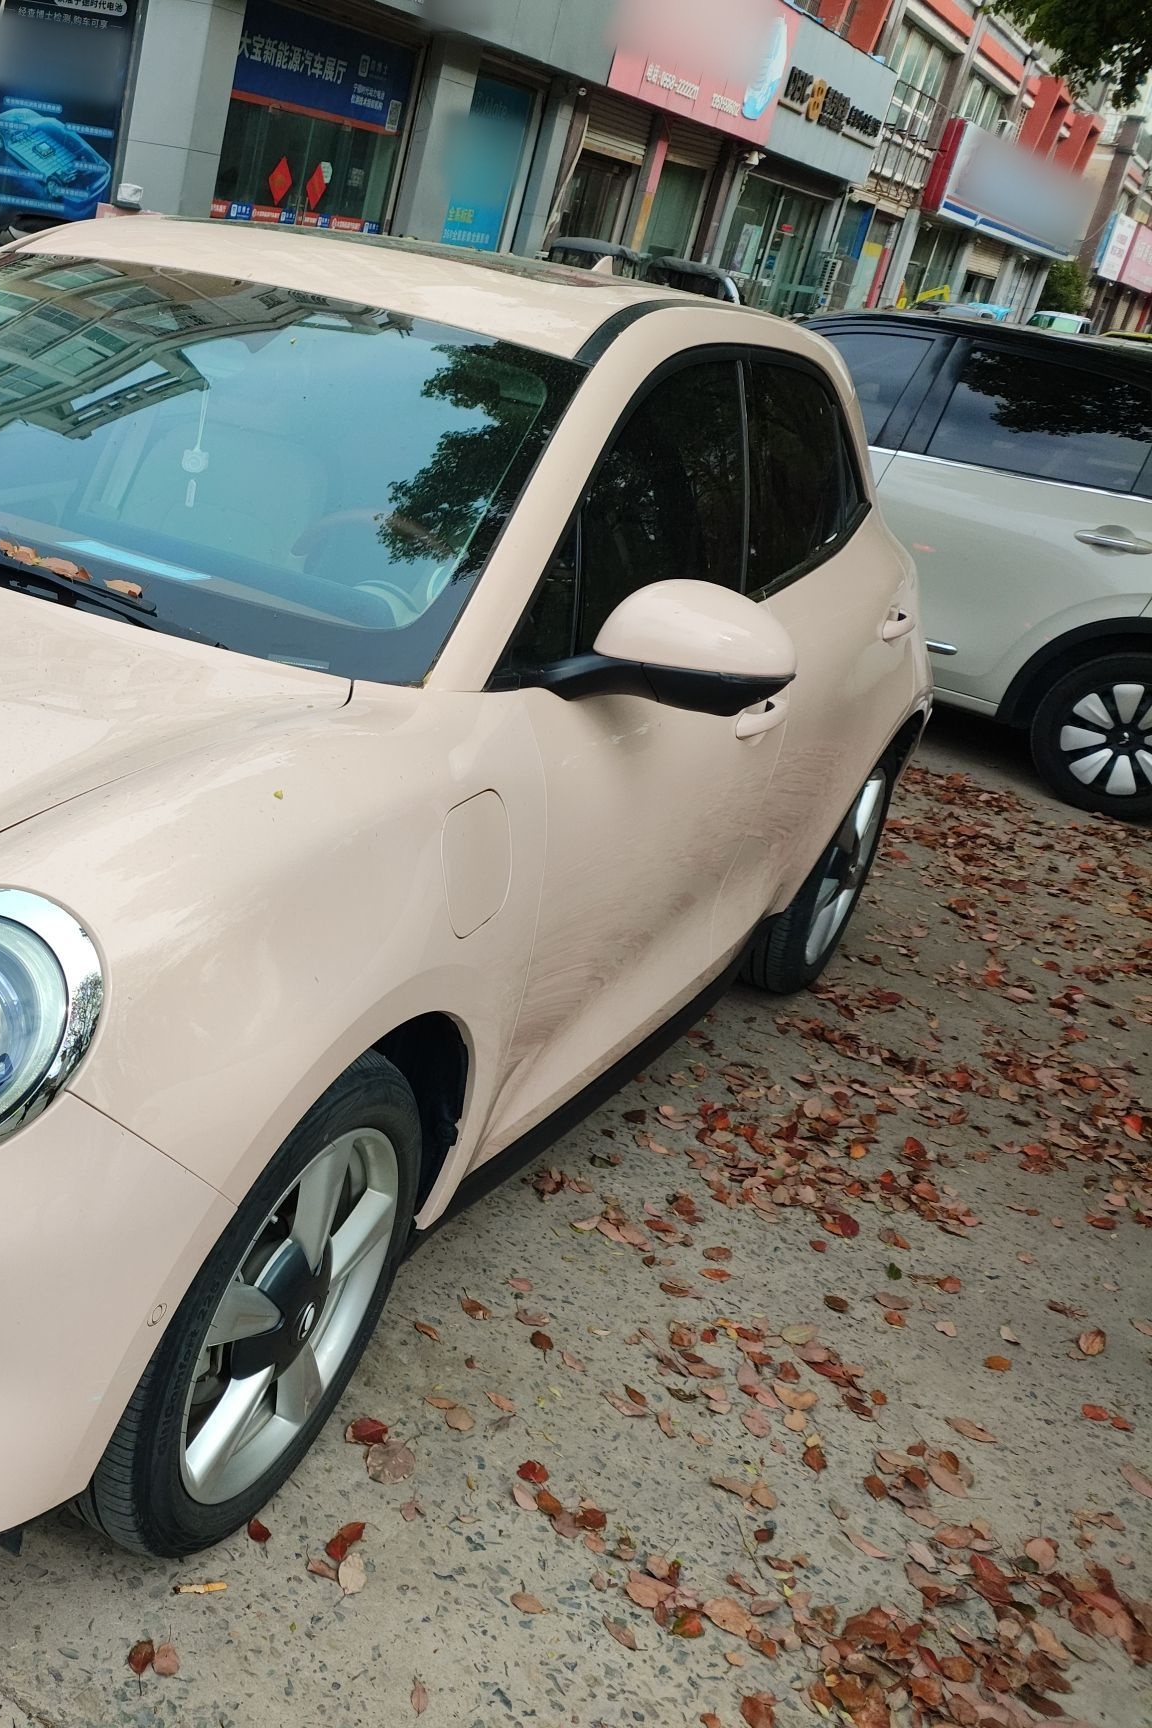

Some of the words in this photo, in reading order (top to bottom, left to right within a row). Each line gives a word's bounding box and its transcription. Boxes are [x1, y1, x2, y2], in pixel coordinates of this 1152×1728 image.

[18, 6, 109, 30] 经查博士检测,购车可享
[237, 30, 348, 85] 大宝新能源汽车展厅
